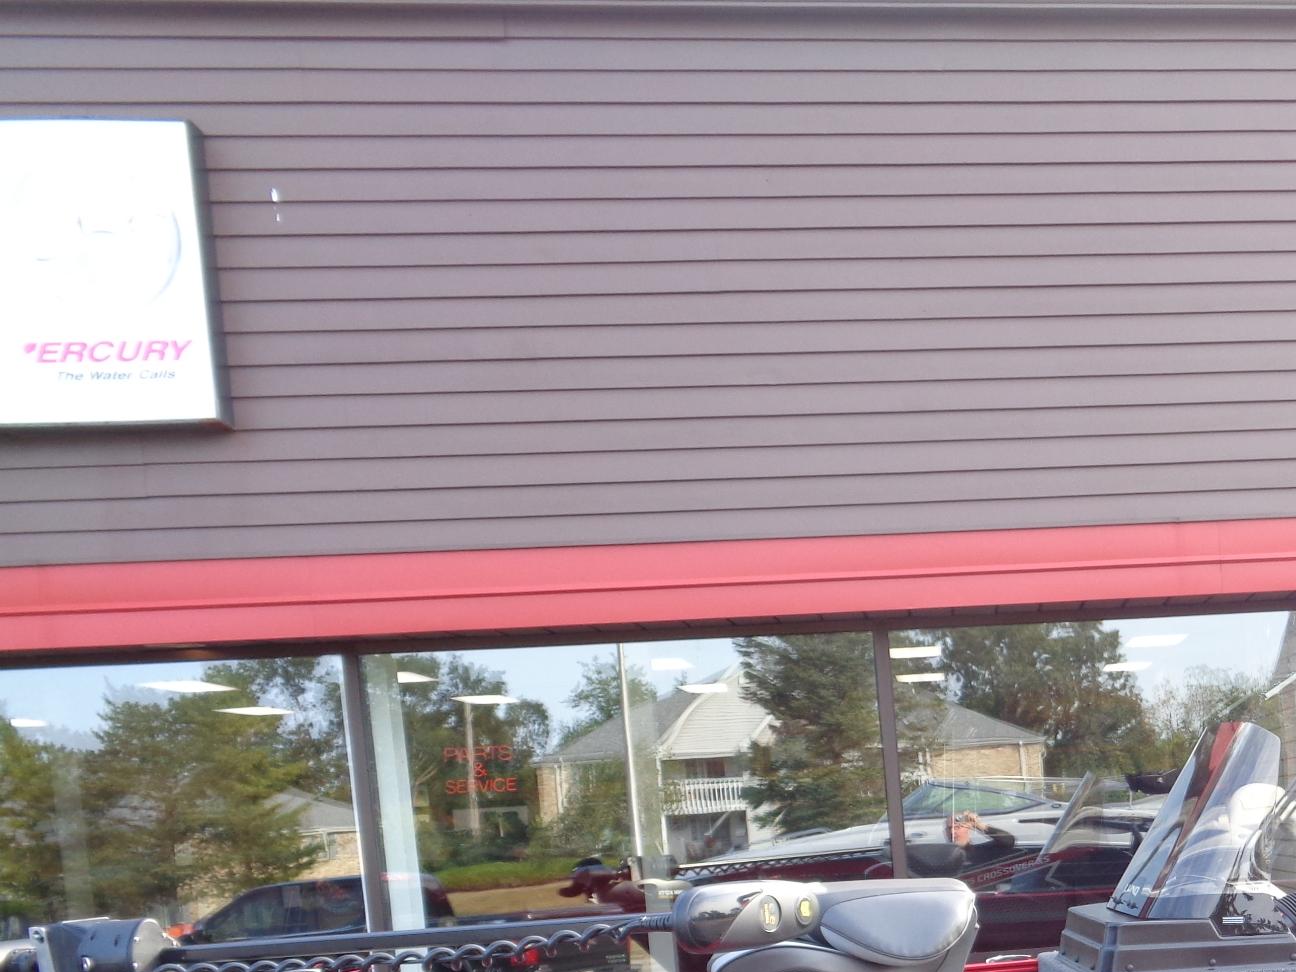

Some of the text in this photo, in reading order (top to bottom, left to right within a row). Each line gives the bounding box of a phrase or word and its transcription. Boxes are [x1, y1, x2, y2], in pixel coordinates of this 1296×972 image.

[57, 369, 176, 381] The Water Calls
[474, 762, 488, 777] &
